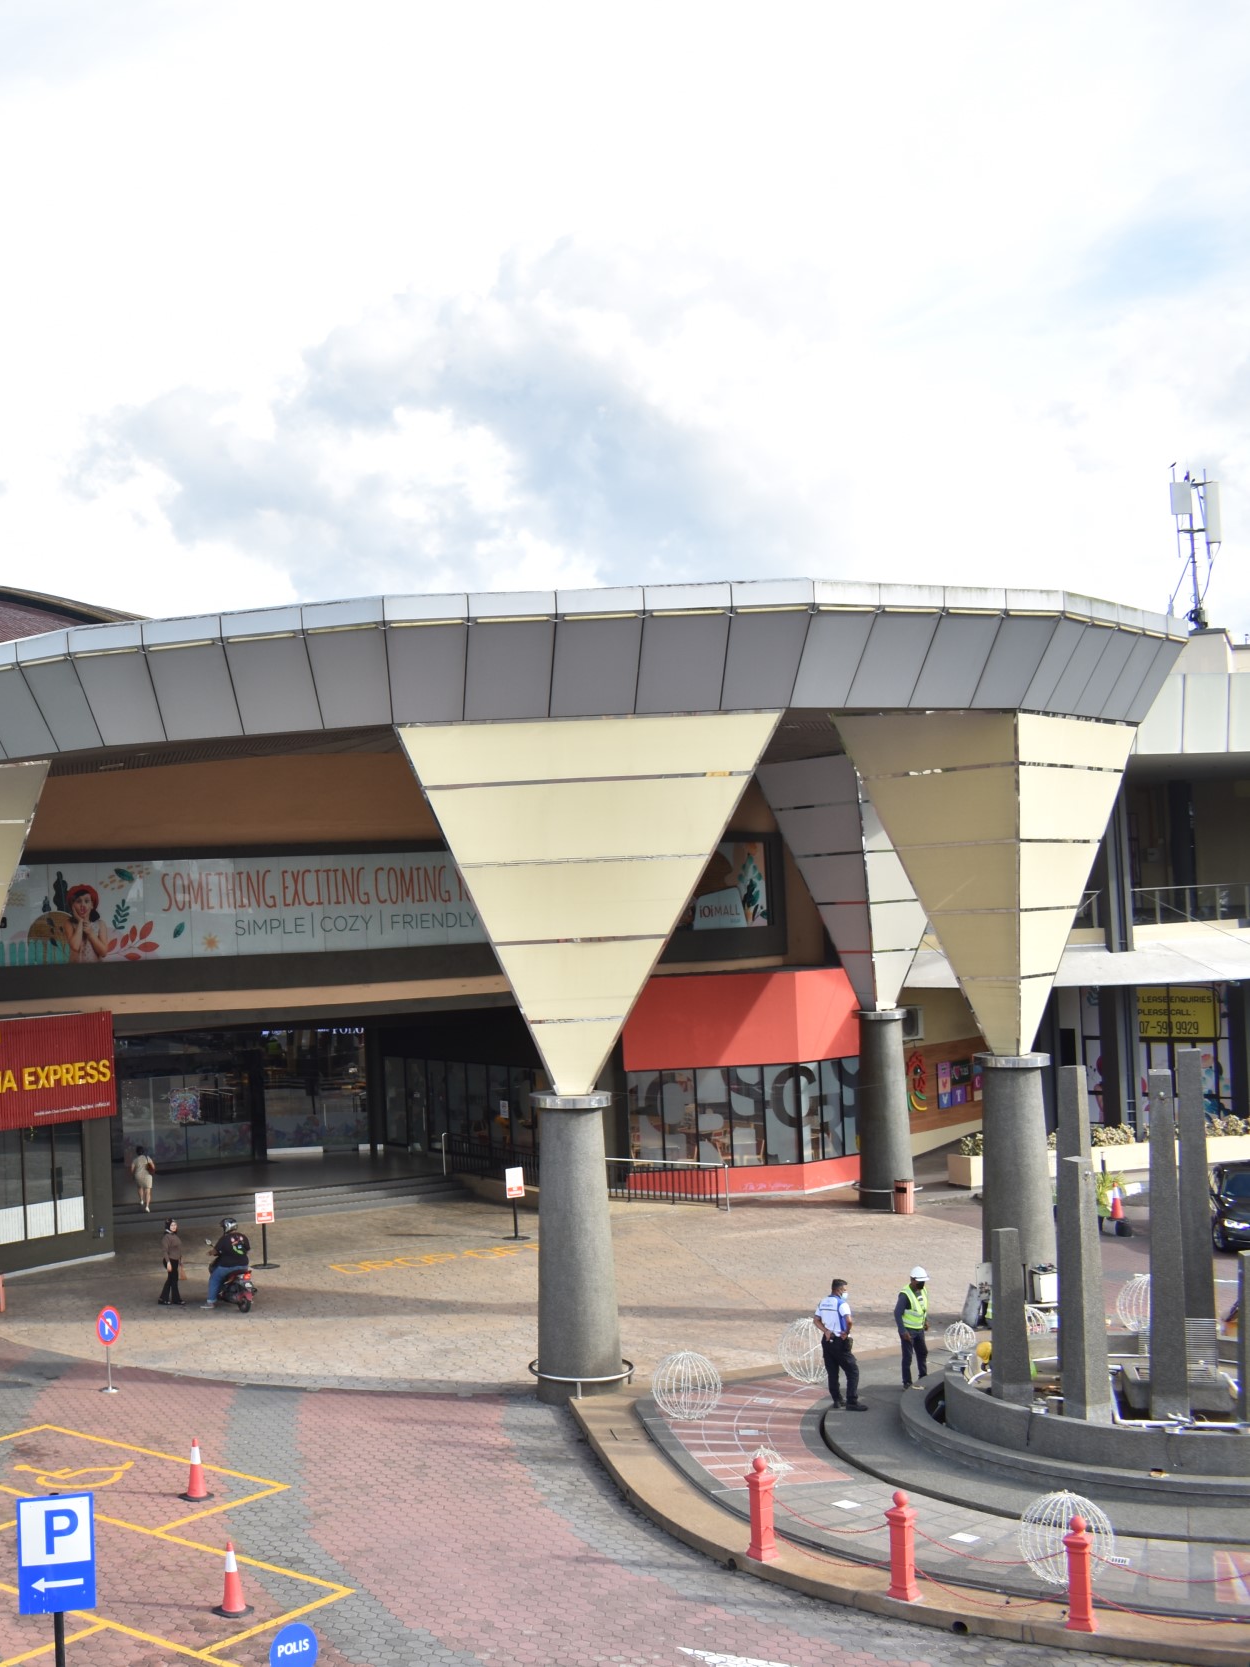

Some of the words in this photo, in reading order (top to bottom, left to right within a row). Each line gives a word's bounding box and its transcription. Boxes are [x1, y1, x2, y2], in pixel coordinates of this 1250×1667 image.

[160, 868, 277, 912] SOMETHING
[282, 866, 370, 908] EXCITING
[375, 864, 451, 904] COMING
[714, 903, 741, 917] MALL
[235, 916, 306, 936] SIMPLE
[320, 914, 372, 933] COZY
[390, 911, 478, 931] FRIENDLY
[1169, 995, 1212, 1003] ENQUIRIES
[1138, 1008, 1168, 1016] PLEASE
[1175, 1020, 1199, 1035] 9929
[23, 1058, 111, 1091] EXPRESS
[44, 1508, 79, 1556] P
[277, 1638, 310, 1658] POLIS
